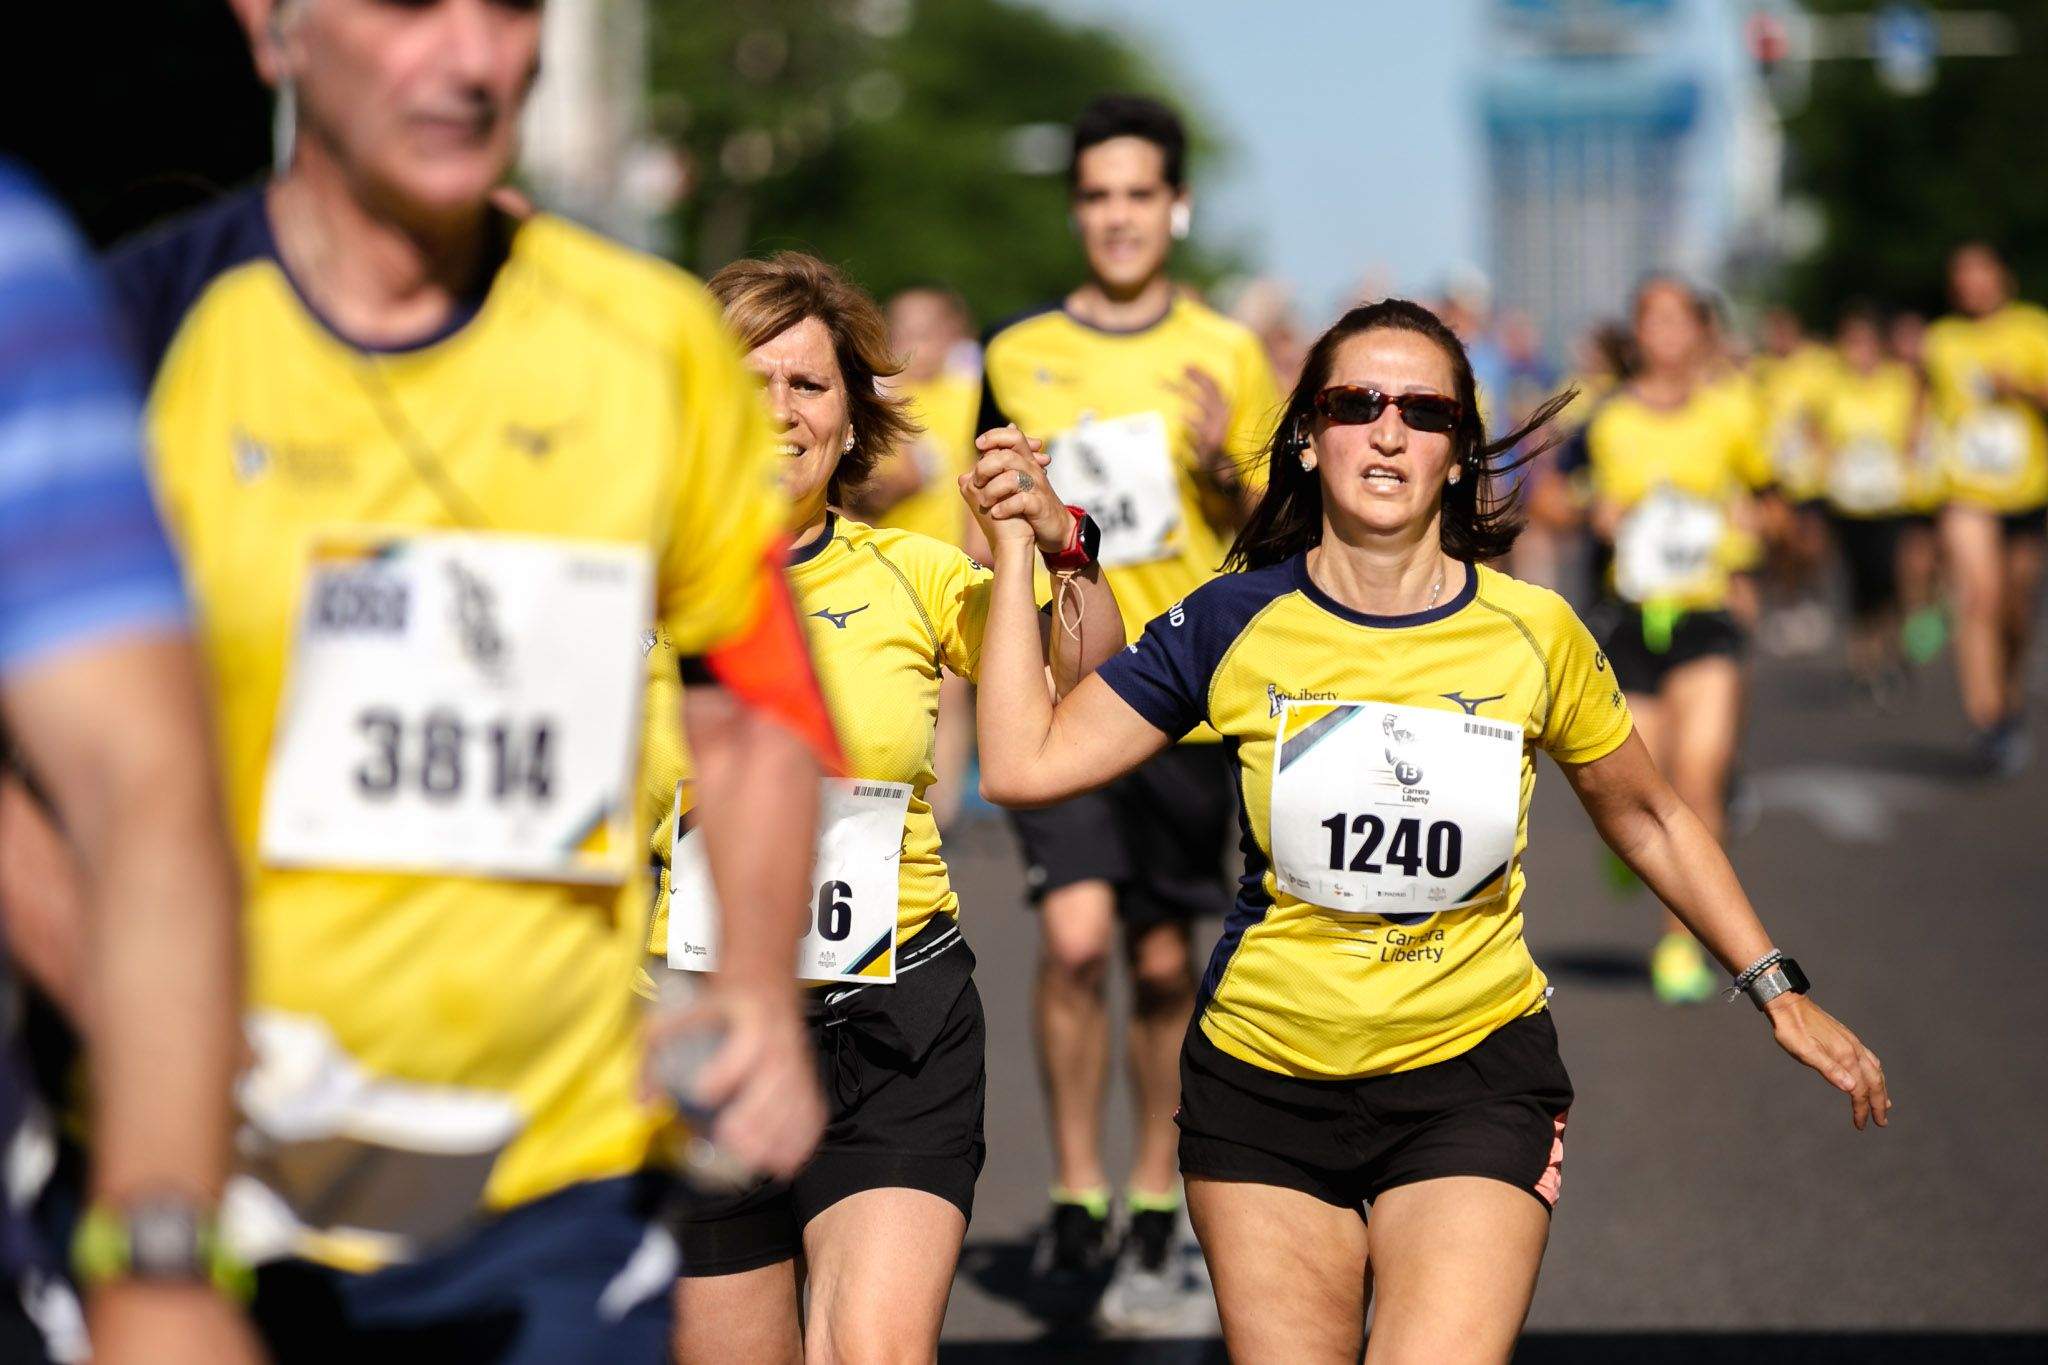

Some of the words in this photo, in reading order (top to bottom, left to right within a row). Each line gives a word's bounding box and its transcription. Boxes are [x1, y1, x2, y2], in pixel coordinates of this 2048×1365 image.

[354, 707, 554, 802] 3814
[1321, 812, 1463, 879] 1240
[1381, 946, 1445, 964] Liberty
[1386, 929, 1444, 946] Carrera
